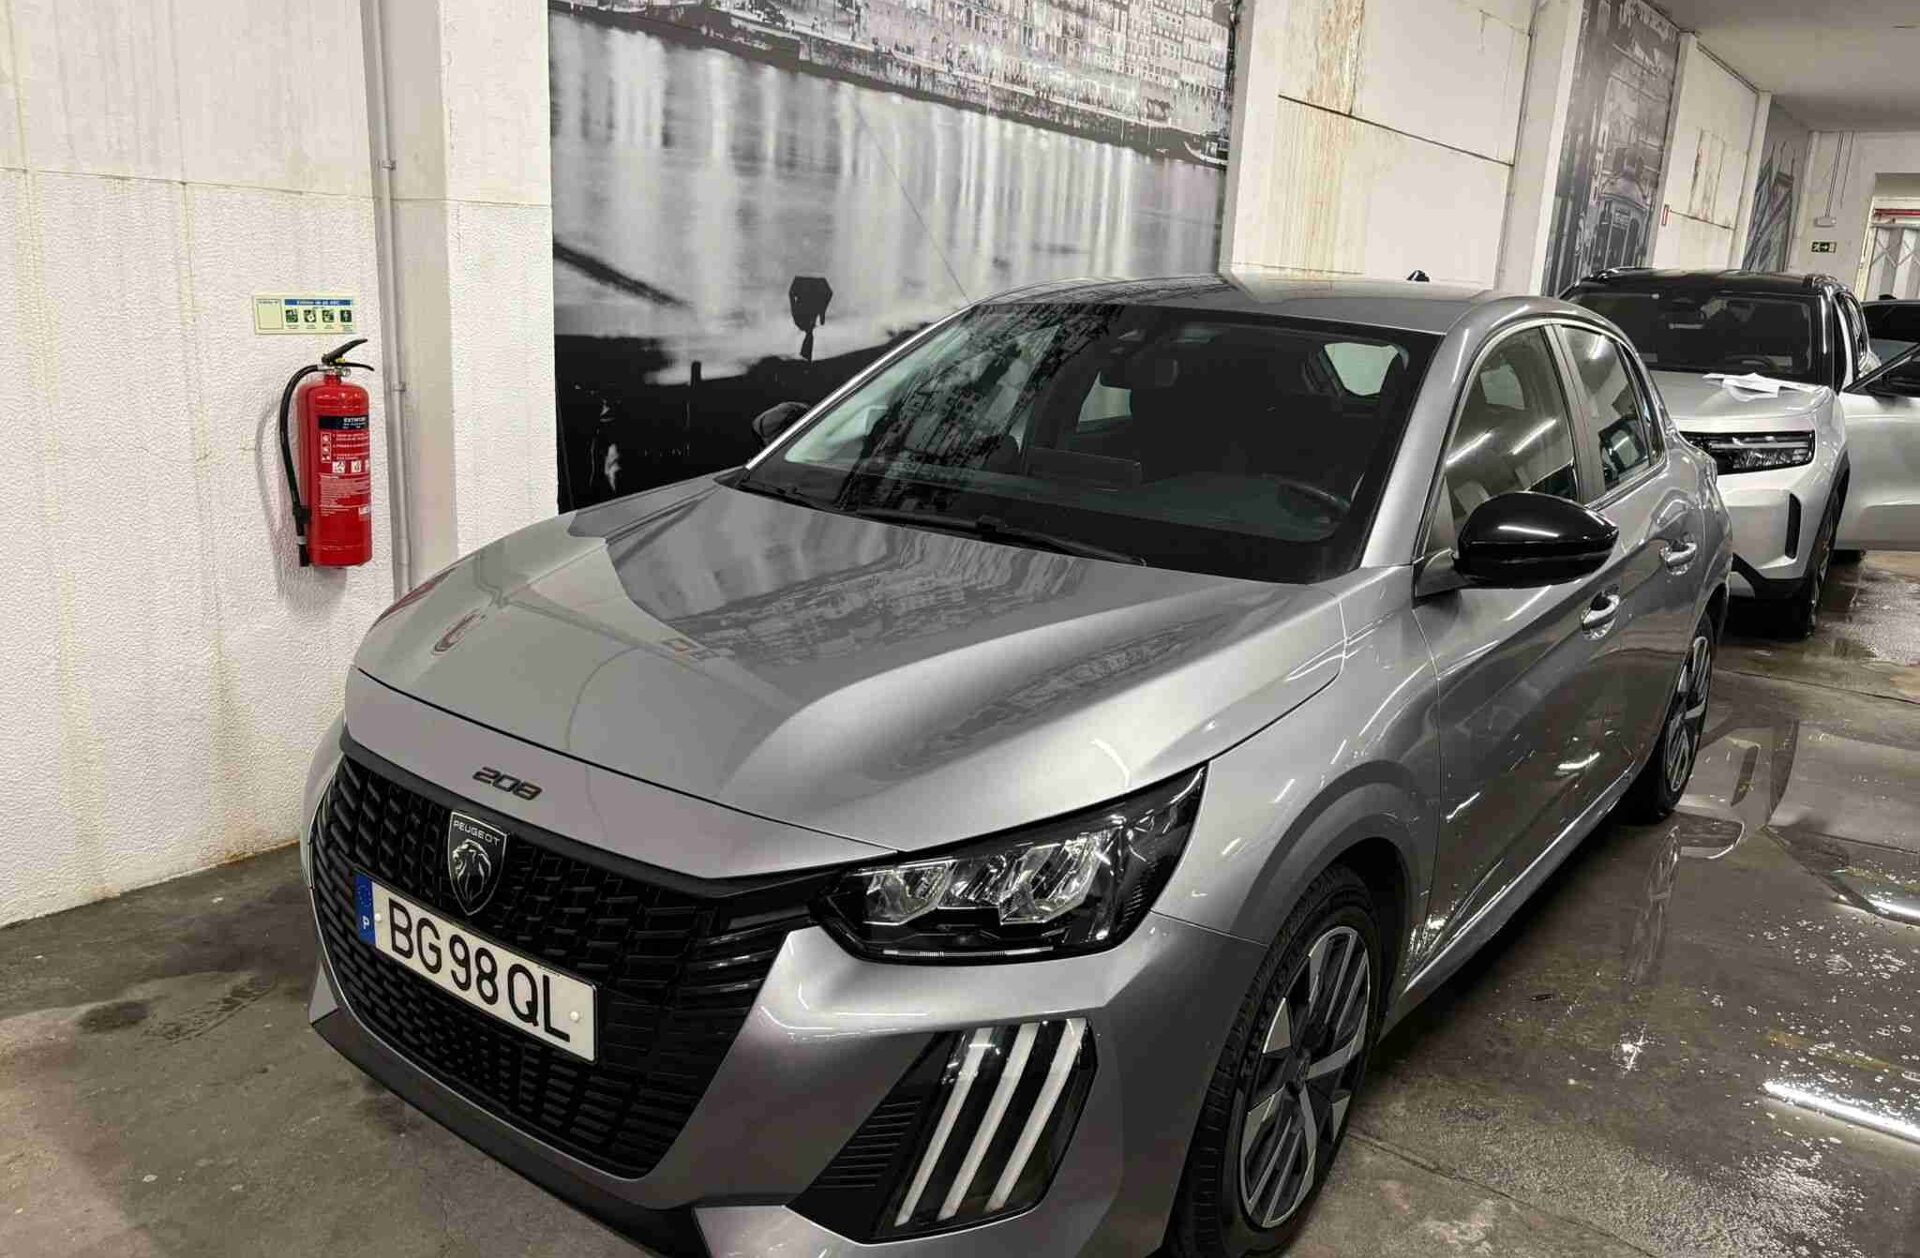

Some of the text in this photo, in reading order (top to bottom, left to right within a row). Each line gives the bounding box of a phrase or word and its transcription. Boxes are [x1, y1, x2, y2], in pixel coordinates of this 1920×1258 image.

[472, 767, 542, 800] 208
[453, 820, 500, 846] PEUGEOT
[362, 915, 370, 930] P
